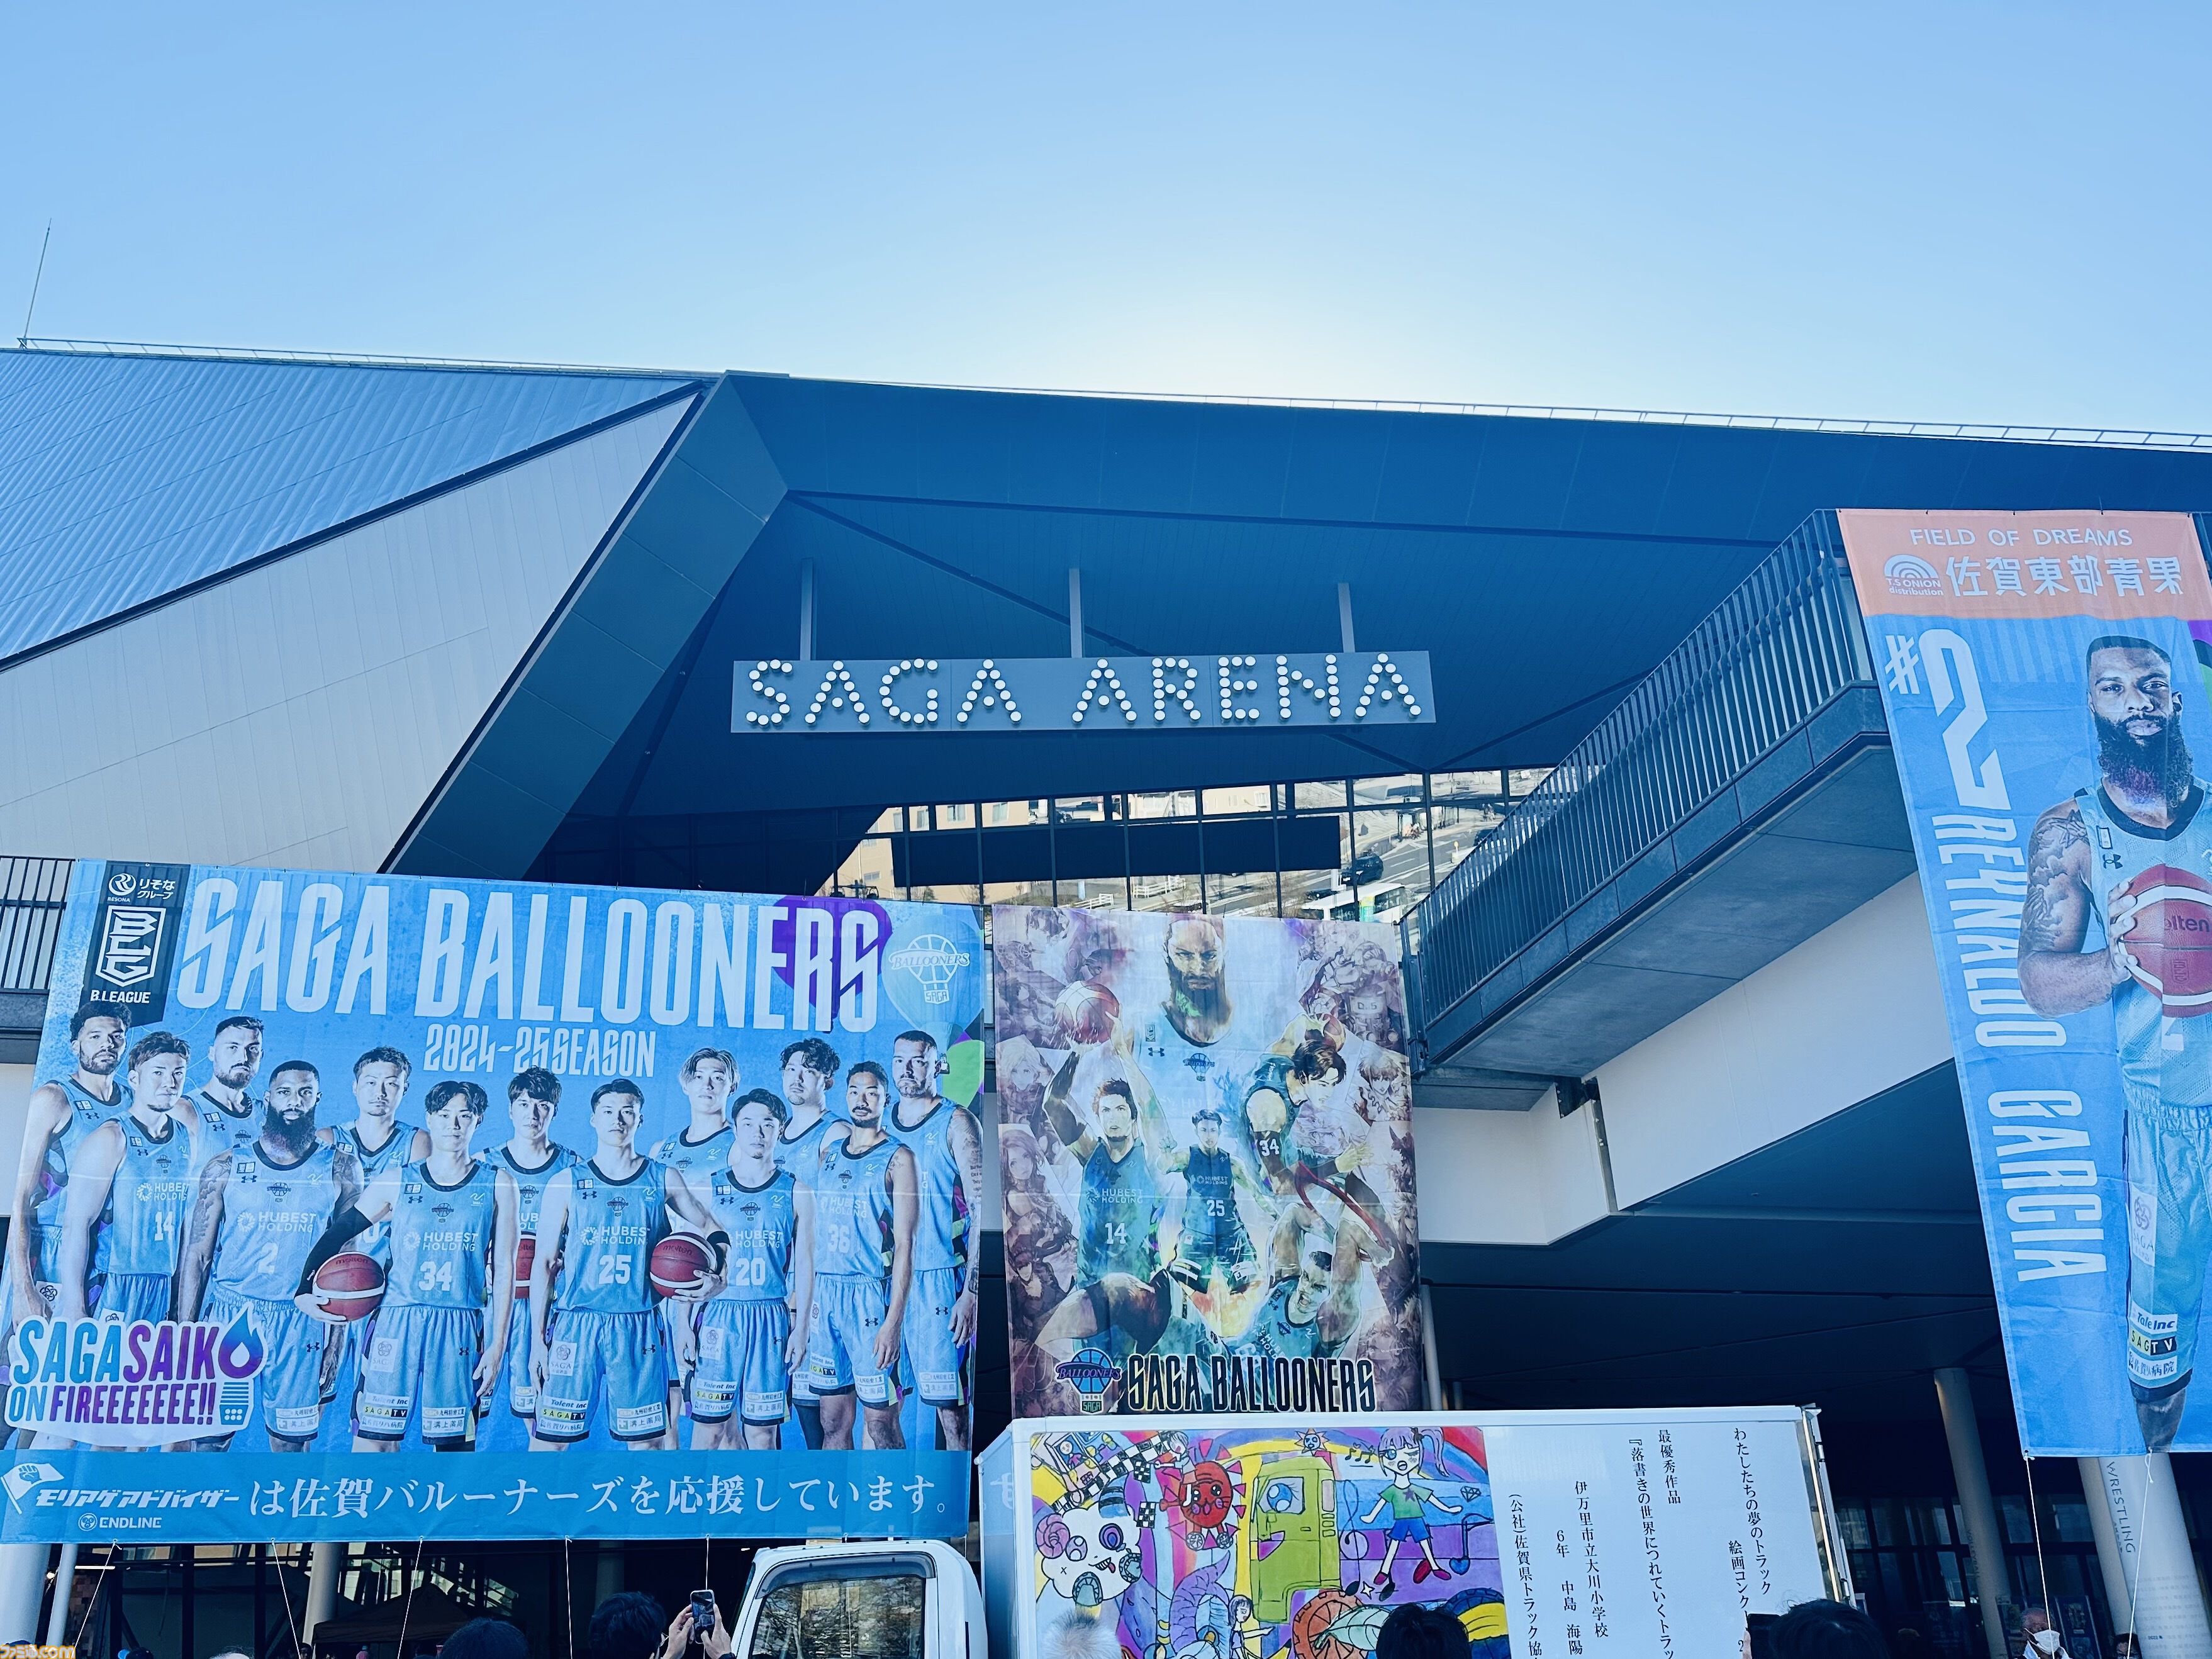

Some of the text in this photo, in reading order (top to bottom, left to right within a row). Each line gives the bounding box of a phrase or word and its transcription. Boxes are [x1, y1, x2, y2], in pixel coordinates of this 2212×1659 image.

[1909, 528, 2133, 547] FIELD OF DREAMS
[1902, 579, 1941, 588] ONION
[1946, 554, 2184, 598] 佐賀東部青果
[1889, 586, 1944, 596] distribution
[745, 652, 1422, 725] SAGA ARENA
[139, 878, 176, 890] りそな
[137, 890, 174, 900] グループ
[1931, 813, 2067, 1047] REYNALDO
[177, 877, 883, 1034] SAGA BALLOONERS
[893, 954, 969, 968] BALLOONERS
[90, 989, 152, 1004] B.LEAGUE
[925, 991, 948, 1002] SAGA
[1260, 1138, 1280, 1157] 34
[1102, 1188, 1144, 1196] HUBEST
[1987, 1090, 2107, 1282] GARCIA
[1206, 1199, 1226, 1217] 25
[154, 1211, 175, 1241] 14
[257, 1222, 313, 1233] HOLDING
[258, 1212, 316, 1224] HUBEST
[423, 1232, 479, 1243] HUBEST
[735, 1230, 784, 1239] HUBEST
[828, 1224, 850, 1254] 36
[1105, 1222, 1127, 1245] 14
[422, 1242, 476, 1252] HOLDING
[257, 1242, 279, 1275] 2
[335, 1257, 369, 1265] molten
[417, 1261, 452, 1292] 34
[598, 1254, 632, 1285] 25
[735, 1257, 766, 1286] 20
[2153, 1321, 2176, 1330] Inc
[550, 1361, 571, 1370] SAGA
[1058, 1367, 1120, 1378] BALLOONERS
[1127, 1353, 1204, 1412] SAGA
[1210, 1354, 1377, 1413] BALLOONERS
[8, 1385, 48, 1422] ON
[551, 1399, 574, 1409] Talent
[1083, 1401, 1101, 1412] SAGA
[1658, 1429, 1681, 1504] 最優秀作品
[1734, 1427, 1771, 1595] わたしたちの夢のトラック
[2106, 1461, 2136, 1553] WRESTLING
[99, 1516, 162, 1529] ENDLINE
[1575, 1480, 1609, 1638] 伊万里市立大川小学校
[1508, 1494, 1542, 1659] (公社)佐賀県トラック協
[1556, 1529, 1583, 1655] 6年 中島 海陽
